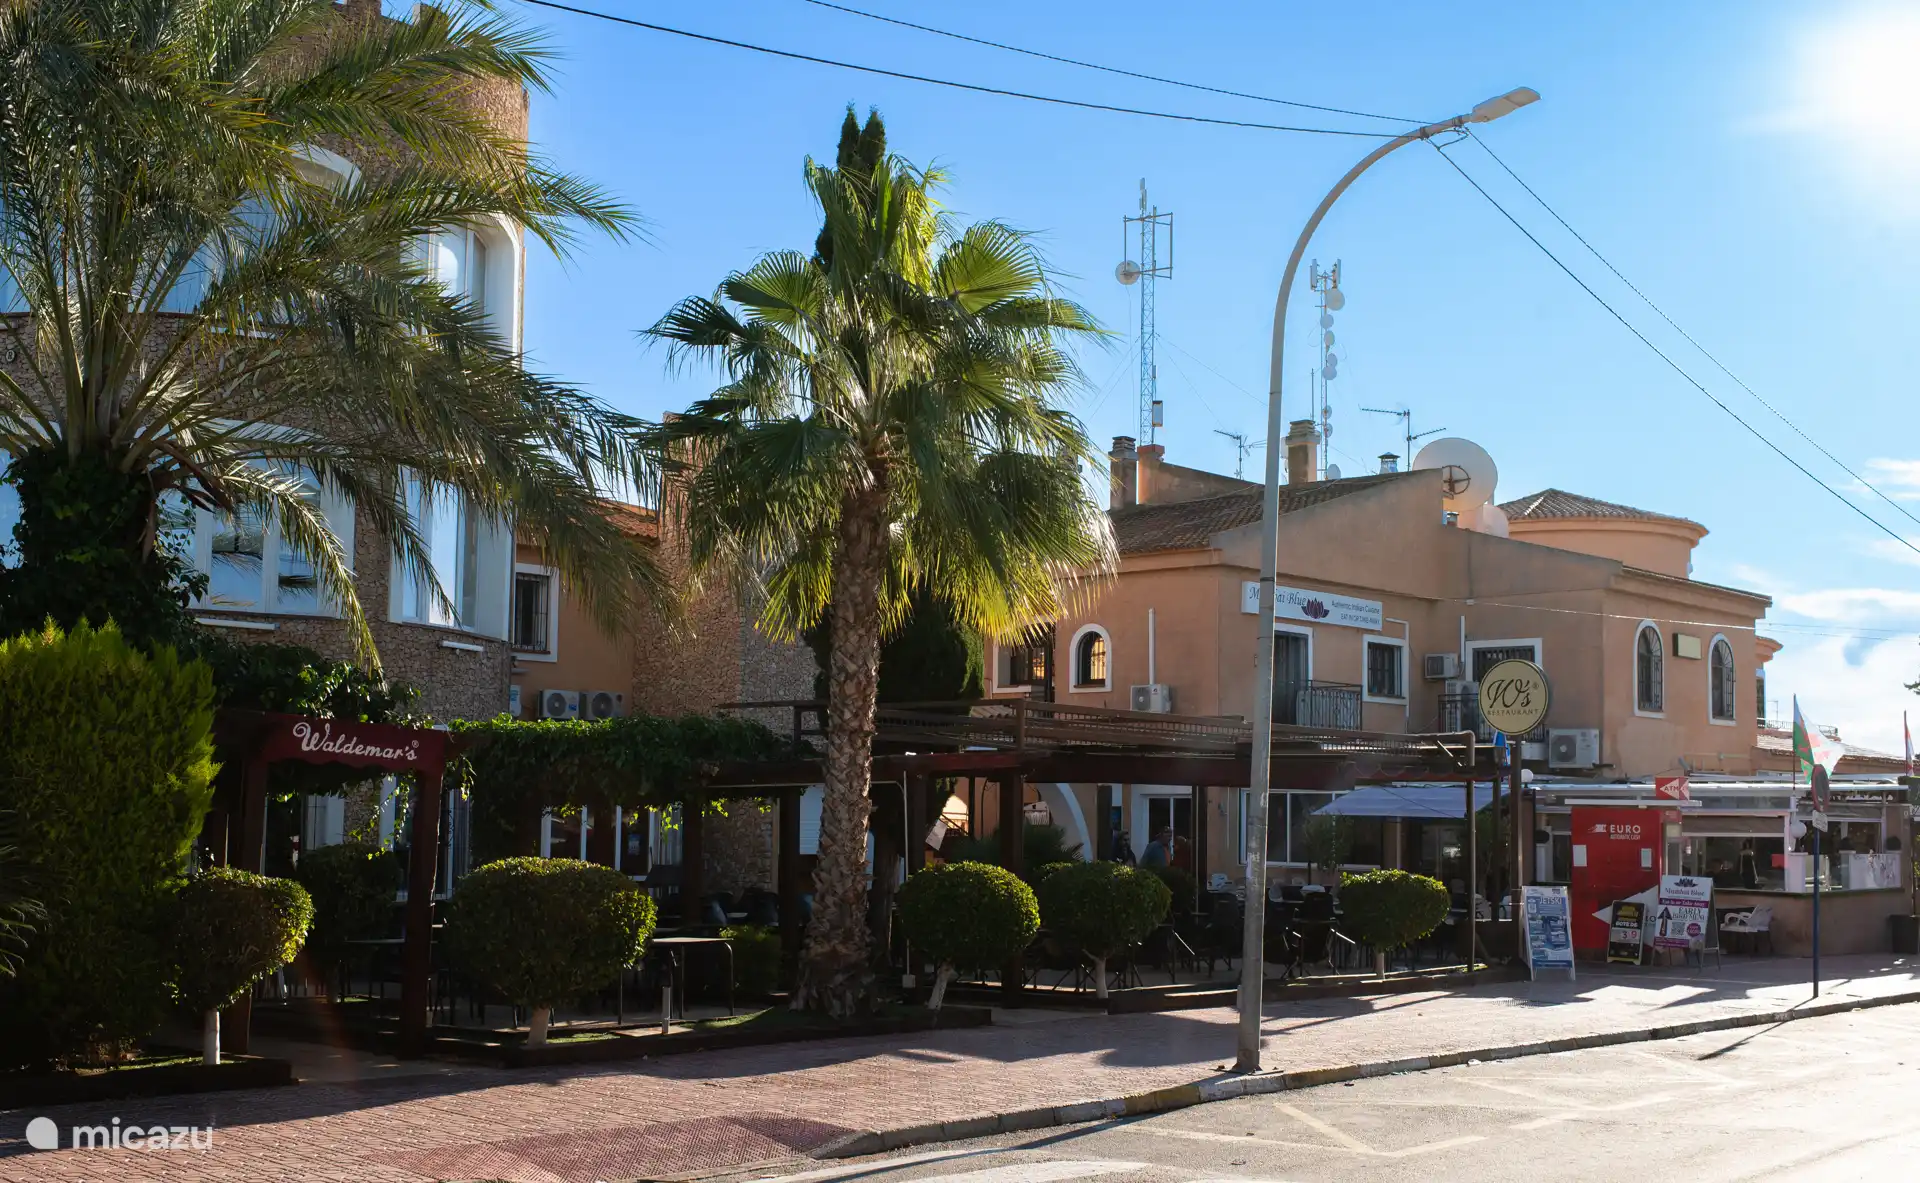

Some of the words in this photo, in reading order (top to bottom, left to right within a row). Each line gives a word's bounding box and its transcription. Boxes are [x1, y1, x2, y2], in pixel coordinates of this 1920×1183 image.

[1287, 591, 1307, 606] Blue
[1487, 708, 1540, 717] RESTAURANT
[293, 721, 418, 761] Waldemar's
[1610, 824, 1641, 834] EURO
